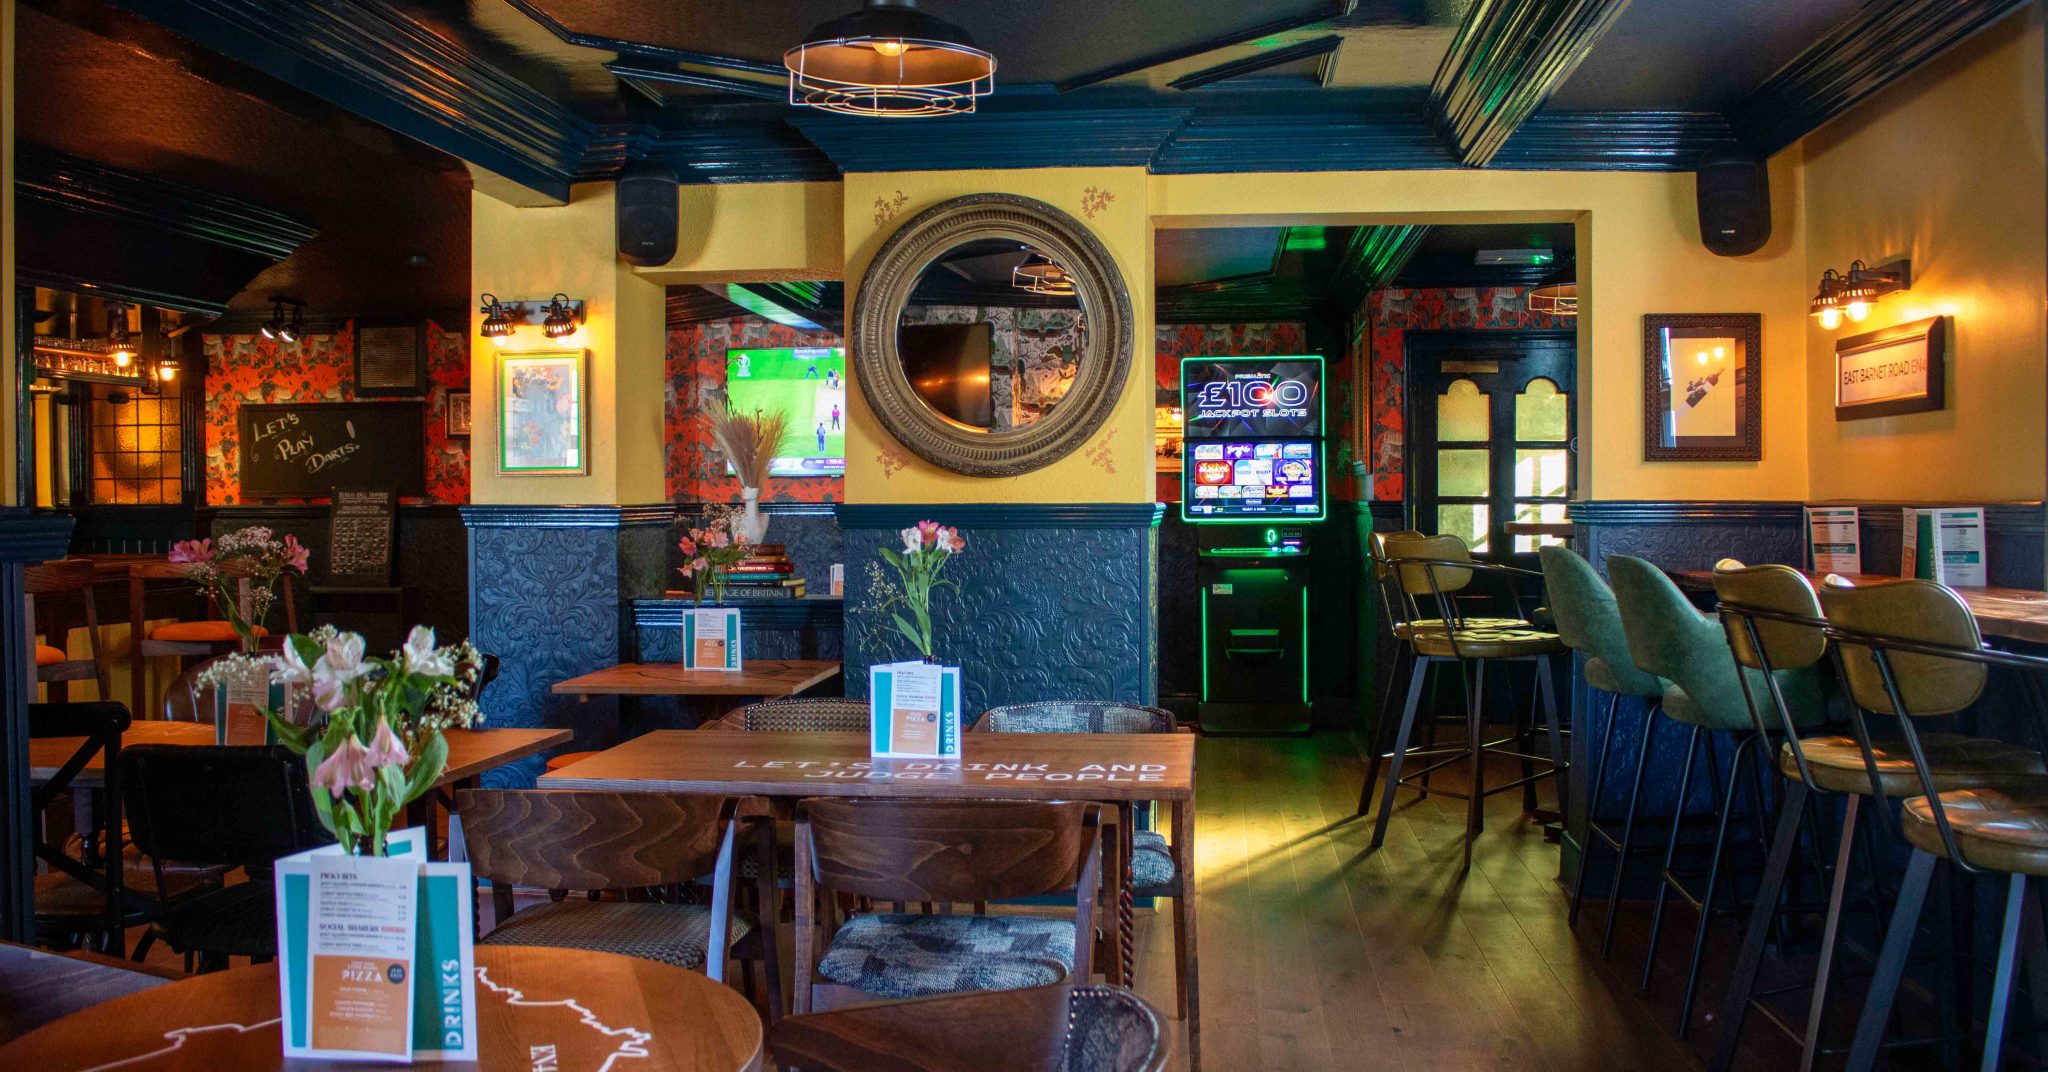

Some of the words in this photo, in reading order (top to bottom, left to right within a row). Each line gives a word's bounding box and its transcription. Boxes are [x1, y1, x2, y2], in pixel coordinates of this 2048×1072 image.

[1843, 370, 1859, 385] EAST
[1860, 364, 1887, 383] BARNET
[1889, 360, 1910, 378] ROAD
[1197, 380, 1308, 408] £100
[1200, 408, 1260, 418] JACKPOT
[1262, 408, 1308, 418] SLOTS
[740, 589, 752, 597] OF
[753, 589, 784, 597] BRITAIN
[945, 711, 954, 753] DRINKS
[733, 761, 873, 769] LET'S
[903, 762, 1049, 772] DRINK
[1079, 763, 1168, 772] AND
[804, 771, 953, 780] JUDGE
[984, 773, 1165, 782] PEOPLE
[341, 970, 384, 983] PIZZA
[441, 959, 462, 1047] DRINKS
